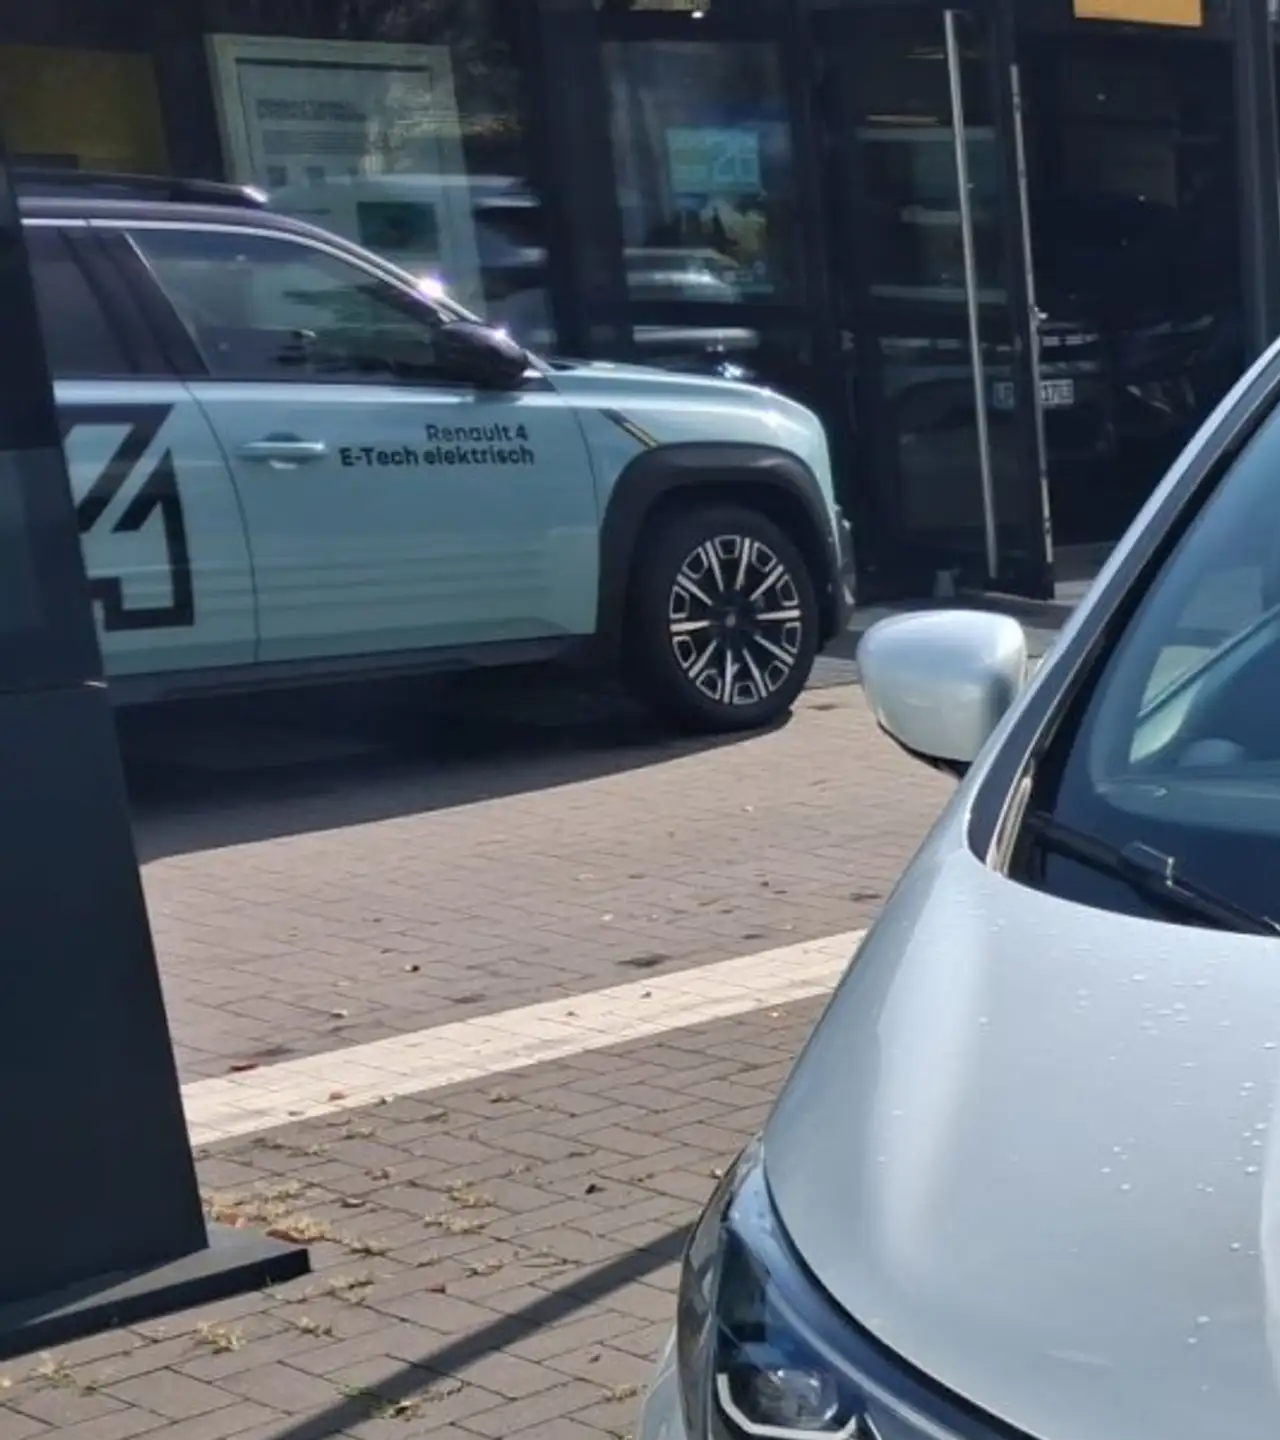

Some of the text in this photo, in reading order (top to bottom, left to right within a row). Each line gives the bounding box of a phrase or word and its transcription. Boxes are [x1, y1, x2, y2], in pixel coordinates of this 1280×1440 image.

[425, 423, 529, 442] Renault 4
[339, 444, 535, 467] E-Tech elektrisch
